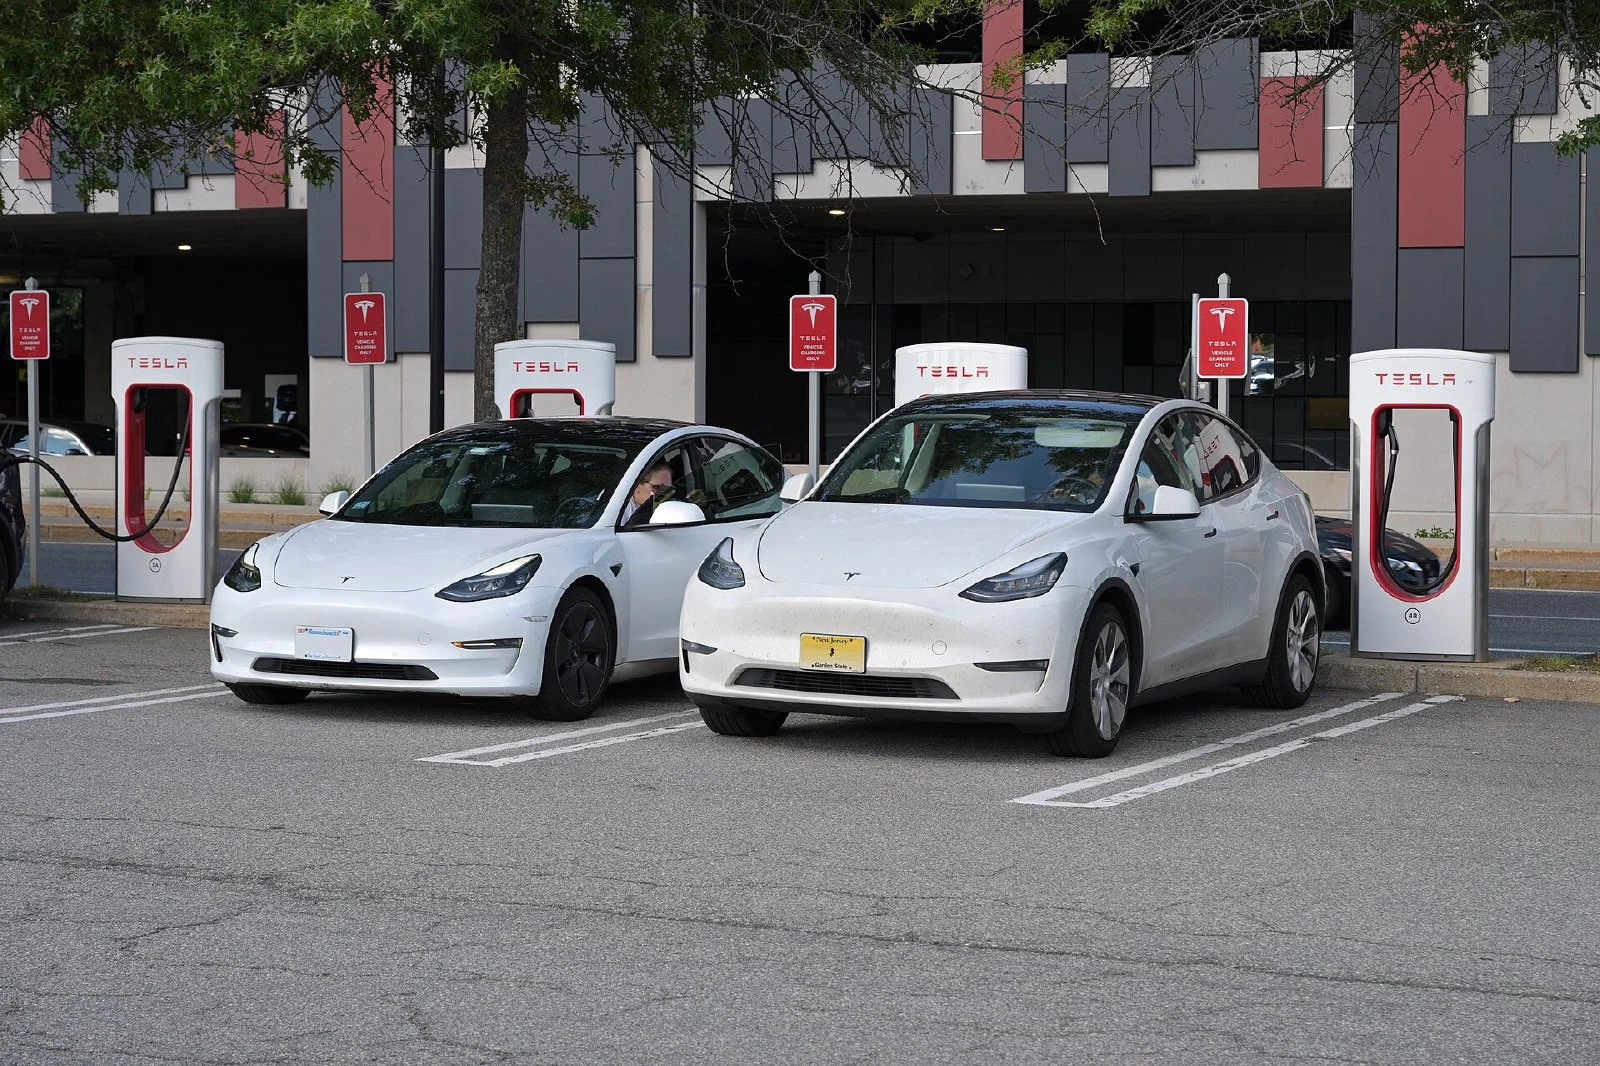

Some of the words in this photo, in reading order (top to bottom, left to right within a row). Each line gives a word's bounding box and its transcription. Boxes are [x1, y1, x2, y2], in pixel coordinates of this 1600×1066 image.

[128, 357, 187, 368] TESLA
[512, 362, 578, 372] TESLA
[916, 366, 989, 377] TESLA
[1375, 373, 1456, 385] TESLA
[830, 637, 849, 645] Jersey
